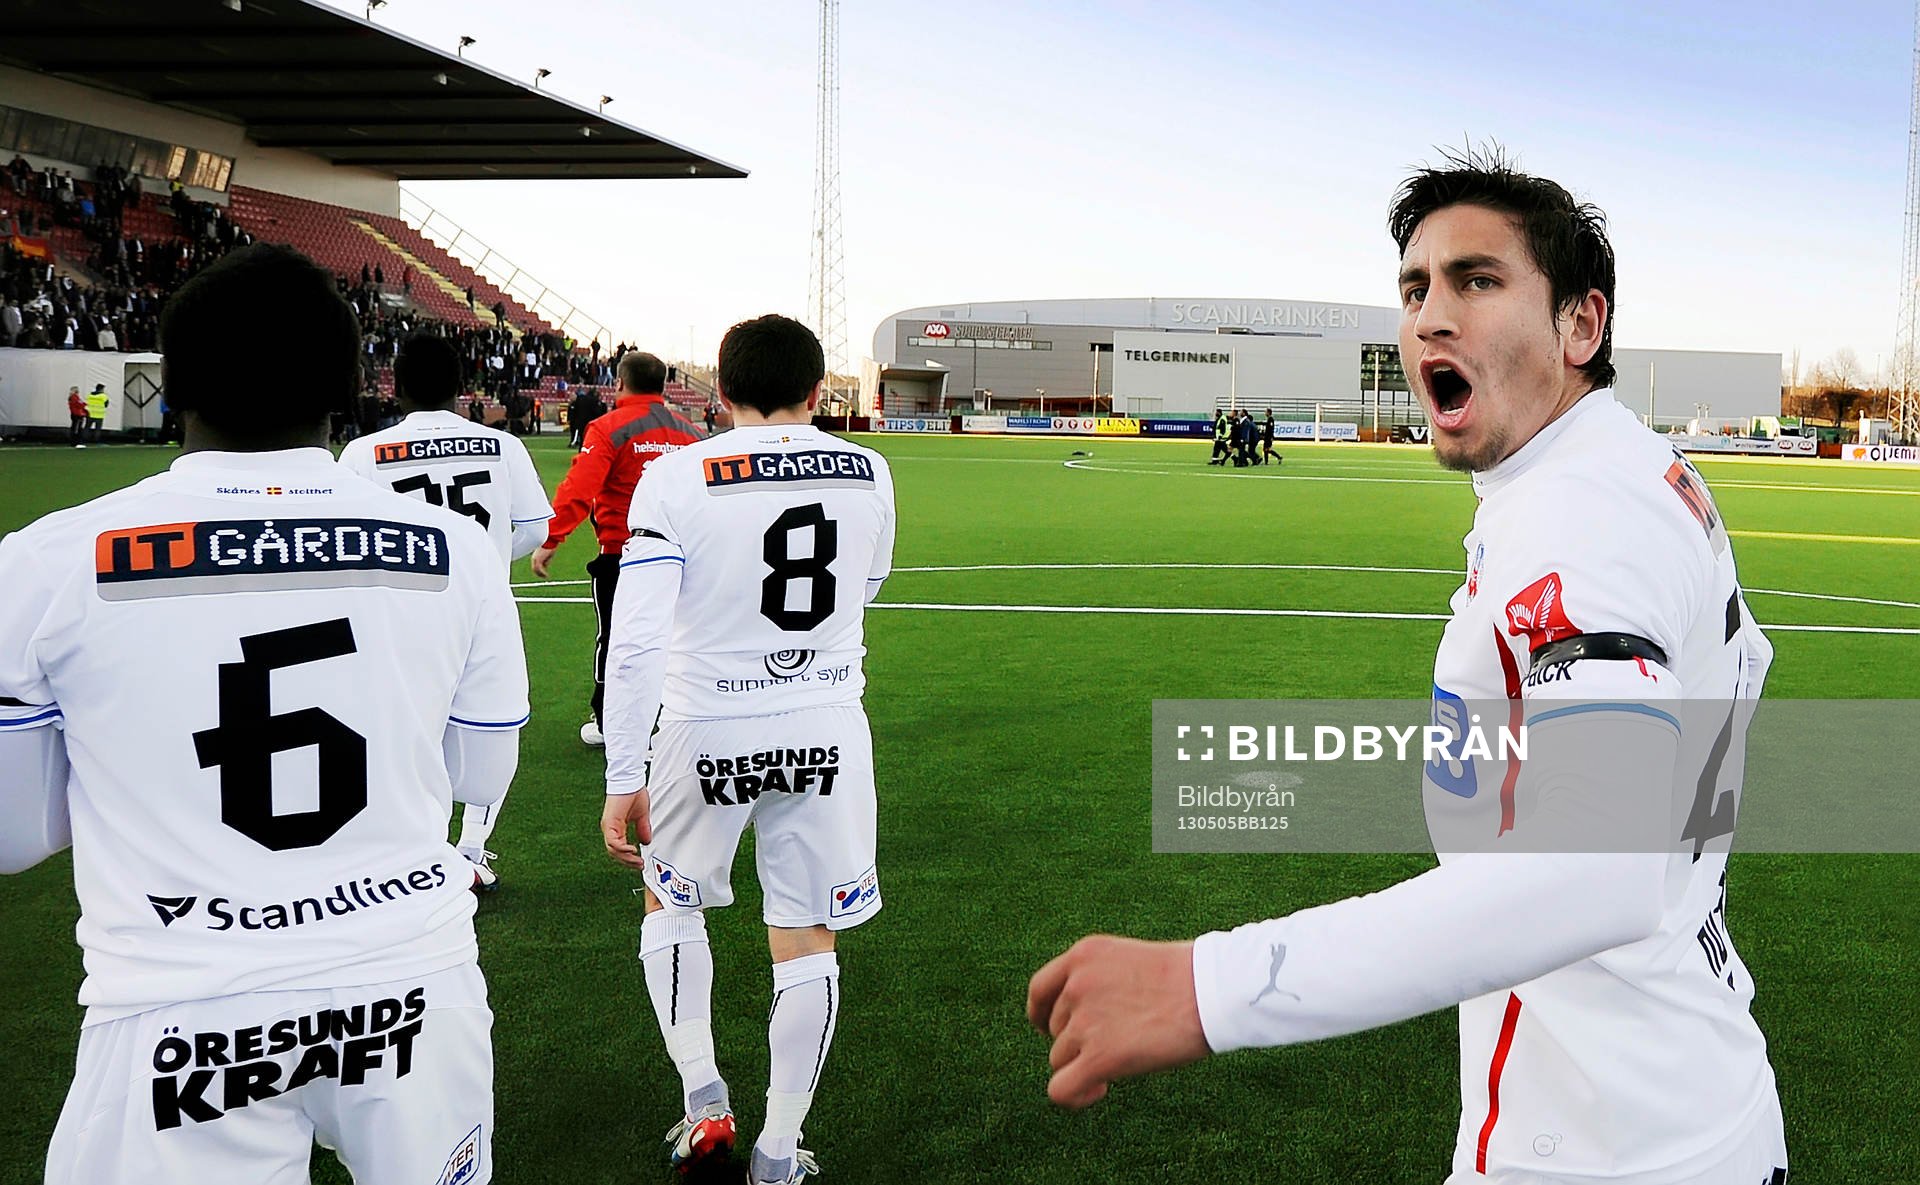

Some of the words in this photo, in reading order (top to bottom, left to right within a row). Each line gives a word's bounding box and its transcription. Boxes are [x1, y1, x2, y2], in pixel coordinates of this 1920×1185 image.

[925, 323, 948, 335] AXA
[1171, 303, 1361, 329] SCANIARINKEN
[1125, 350, 1231, 364] TELGERINKEN
[886, 419, 914, 430] TIPS
[1097, 418, 1138, 427] LUNA
[378, 443, 405, 463] IT
[411, 438, 496, 457] GÅRDEN
[710, 458, 750, 482] IT
[757, 452, 870, 478] GÅRDEN
[216, 487, 261, 495] Skånes
[112, 530, 185, 573] IT
[209, 520, 438, 567] GÅRDEN
[760, 502, 838, 632] 8
[817, 664, 850, 686] syd
[192, 616, 367, 851] 6
[697, 745, 839, 778] ÖRESUNDS
[699, 766, 839, 806] KRAFT
[206, 861, 447, 931] Scandlines
[152, 987, 426, 1073] ÖRESUNDS
[152, 1019, 424, 1131] KRAFT
